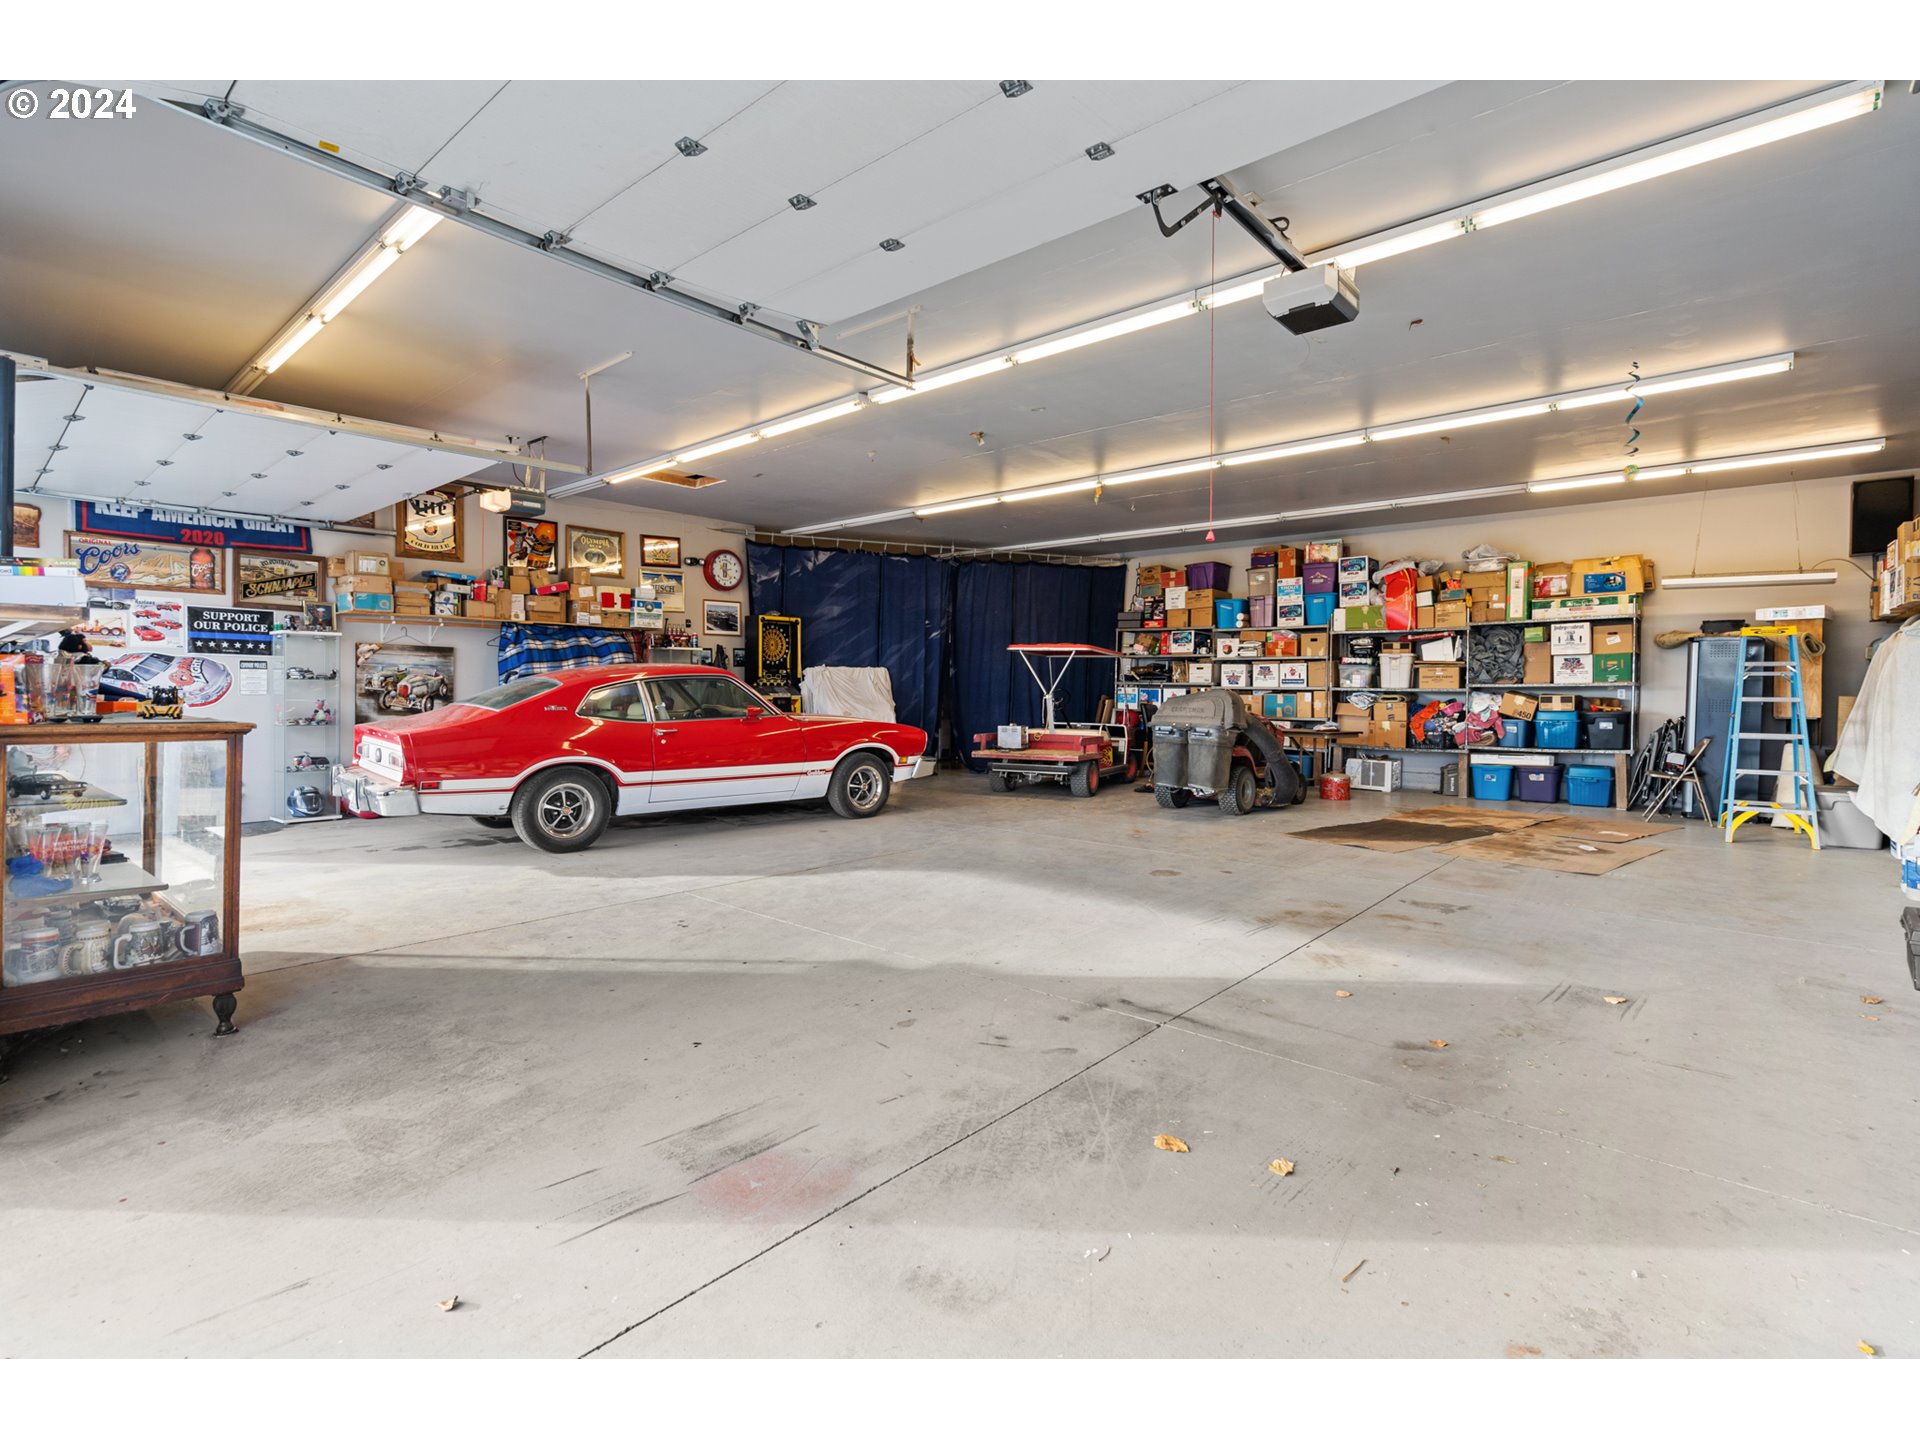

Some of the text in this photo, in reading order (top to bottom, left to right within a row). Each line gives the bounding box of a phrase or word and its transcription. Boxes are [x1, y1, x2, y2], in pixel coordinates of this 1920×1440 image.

[79, 537, 112, 546] ORIGINAL
[180, 528, 225, 546] 2020
[580, 535, 610, 548] OLYMPIA
[75, 542, 142, 576] Coors
[652, 584, 675, 593] USCH
[203, 610, 261, 623] SUPPORT
[193, 621, 269, 633] OUR POLICE
